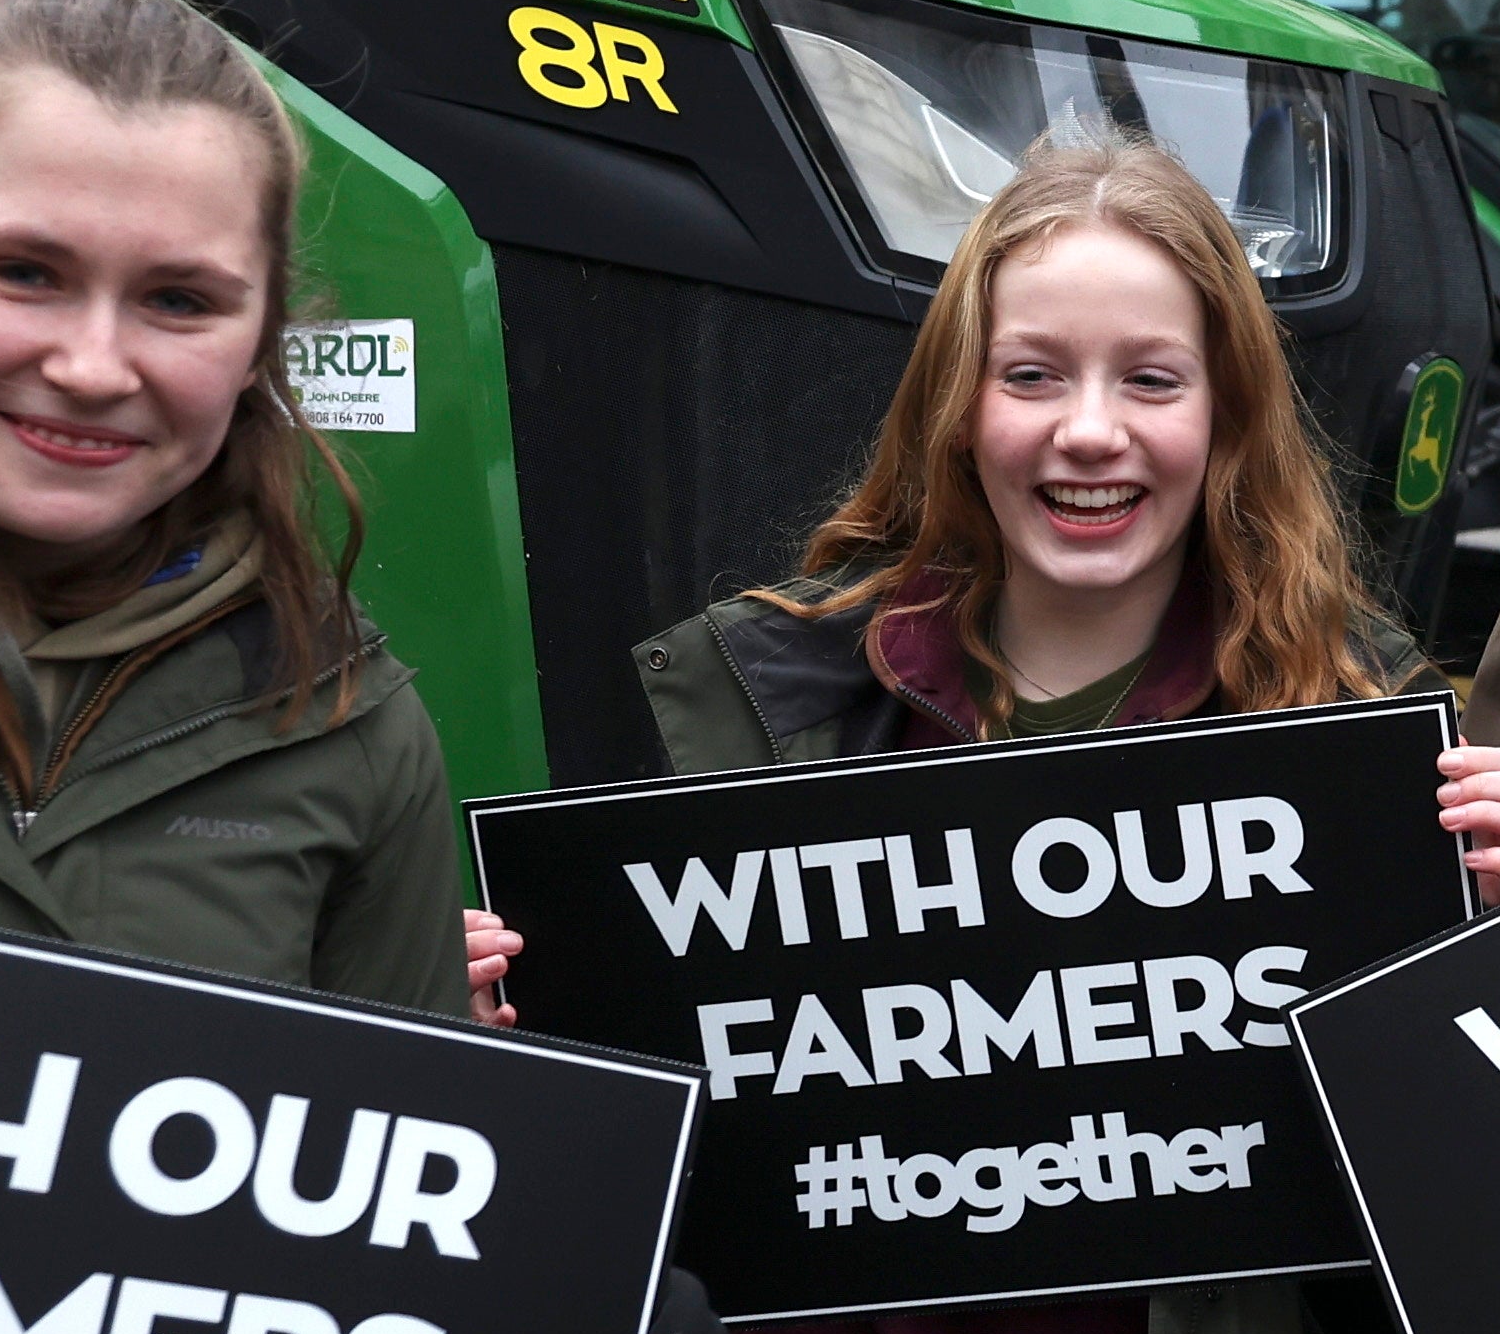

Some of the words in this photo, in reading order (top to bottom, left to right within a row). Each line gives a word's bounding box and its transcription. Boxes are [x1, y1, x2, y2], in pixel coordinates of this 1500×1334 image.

[506, 6, 680, 115] 8R
[309, 391, 340, 403] JOHN
[341, 391, 381, 403] DEERE
[333, 412, 353, 425] 164
[356, 412, 385, 426] 7700
[164, 815, 273, 841] MUSTO
[622, 827, 987, 957] WITH
[1011, 796, 1315, 919] OUR
[696, 945, 1312, 1101] FARMERS
[108, 1076, 497, 1261] OUR
[794, 1111, 1266, 1233] #together
